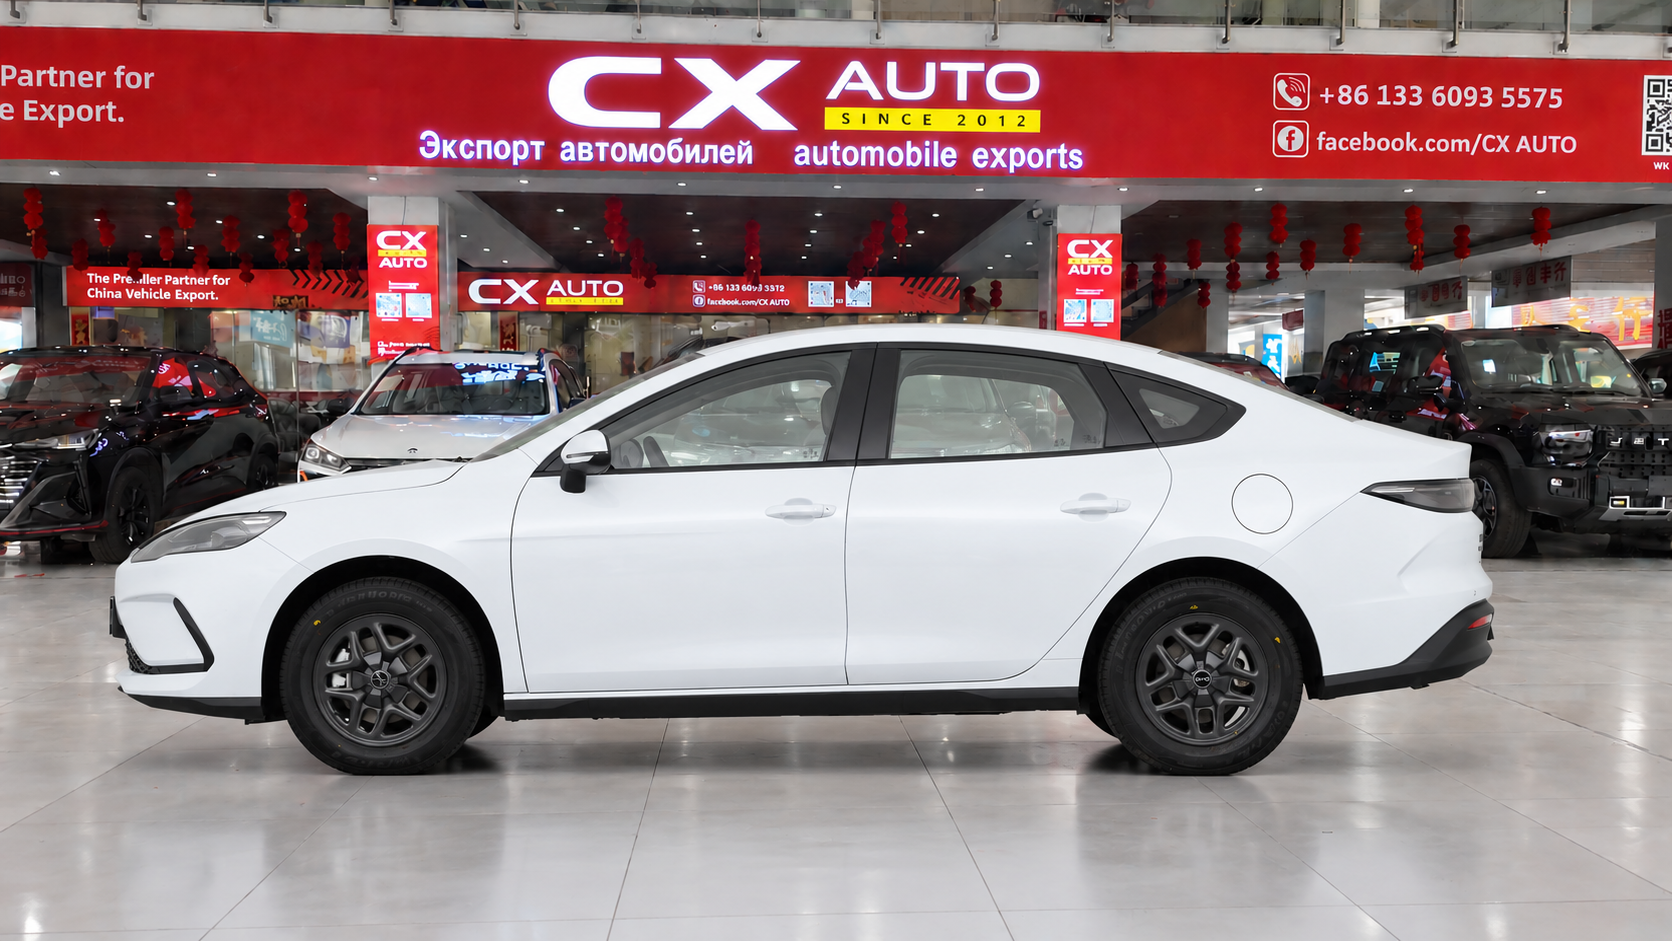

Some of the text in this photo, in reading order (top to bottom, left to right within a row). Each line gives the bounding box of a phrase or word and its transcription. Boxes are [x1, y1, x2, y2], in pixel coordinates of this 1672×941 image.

[1, 64, 155, 89] Partner for
[548, 56, 1041, 131] CX AUTO
[1319, 84, 1563, 109] +86 133 6093 5575
[23, 99, 125, 129] Export.
[841, 112, 1026, 127] SINCE 2012
[418, 130, 754, 165] Экспорт автомобилей
[1316, 130, 1577, 156] facebook.com/CX AUTO
[793, 140, 1084, 174] automobile exports
[376, 230, 427, 251] CX
[1066, 239, 1114, 259] CX
[378, 256, 428, 269] AUTO
[1067, 263, 1113, 276] AUTO
[86, 272, 111, 284] The
[164, 274, 210, 286] Partner
[212, 275, 231, 286] for
[468, 278, 624, 305] CX AUTO
[86, 287, 219, 303] China Vehicle Export.
